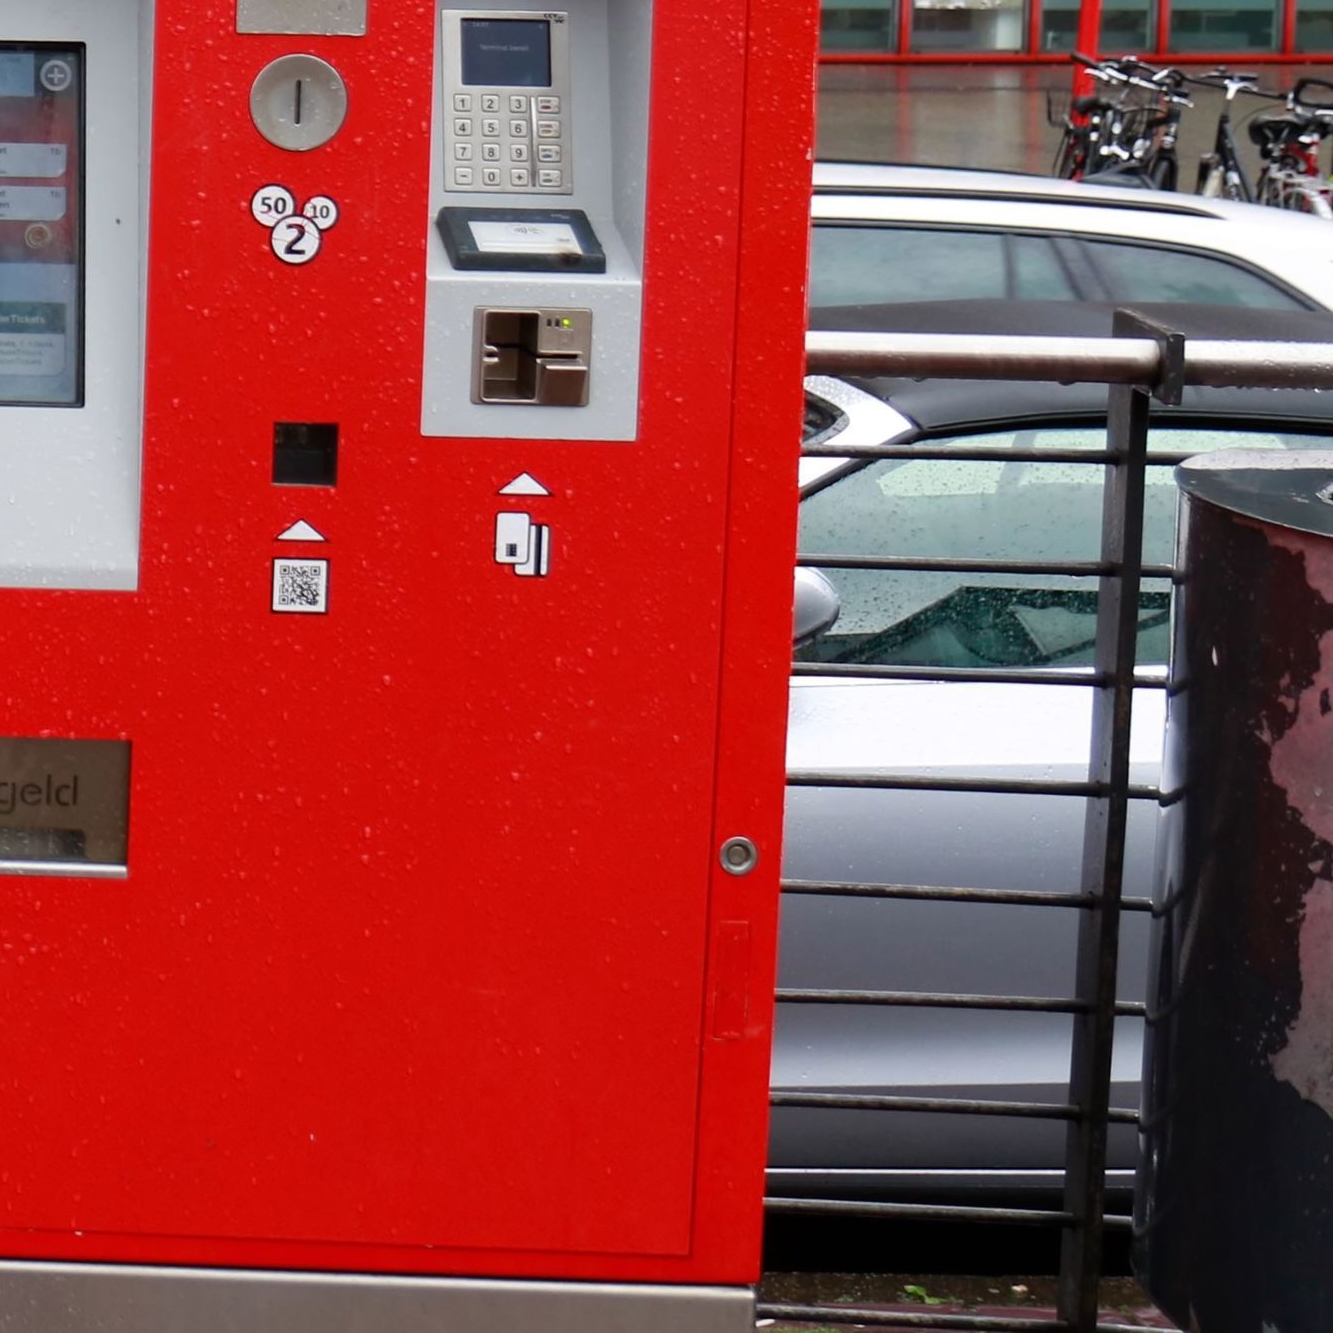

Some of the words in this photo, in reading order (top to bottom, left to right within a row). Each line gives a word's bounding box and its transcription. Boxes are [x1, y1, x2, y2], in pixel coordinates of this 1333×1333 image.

[486, 99, 494, 109] 2
[514, 99, 522, 109] 3
[459, 122, 466, 132] 4
[487, 122, 495, 133] 5
[514, 123, 522, 134] 6
[459, 147, 467, 157] 7
[487, 147, 495, 157] 8
[515, 148, 522, 158] 9
[487, 172, 496, 182] 0
[259, 196, 287, 215] 50
[310, 204, 330, 219] 10
[283, 223, 306, 255] 2
